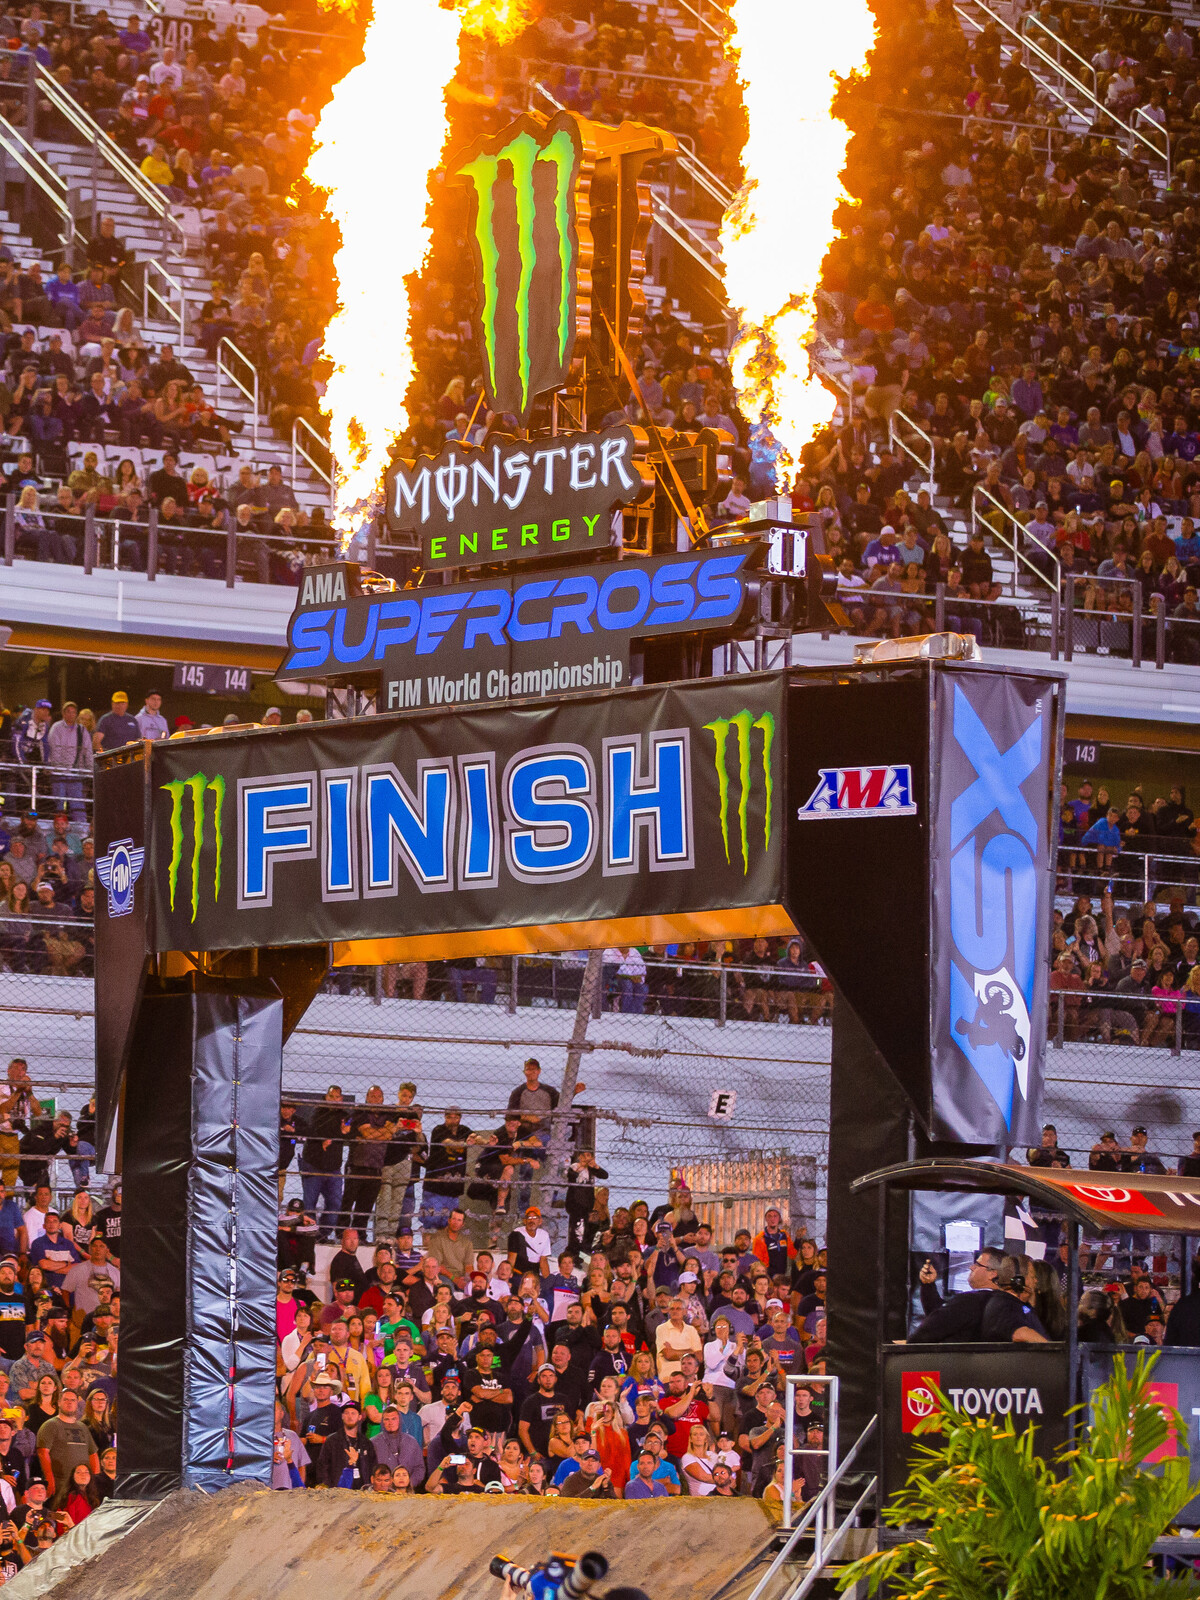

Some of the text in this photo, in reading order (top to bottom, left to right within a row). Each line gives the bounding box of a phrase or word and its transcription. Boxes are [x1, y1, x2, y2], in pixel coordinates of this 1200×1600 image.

[430, 514, 601, 559] ENERGY
[301, 571, 347, 605] AMA
[284, 553, 748, 670] SUPERCROSS
[181, 665, 204, 687] 145
[224, 669, 247, 690] 144
[388, 654, 624, 709] FIM World Championship
[1075, 744, 1096, 763] 143
[800, 765, 916, 812] AMA
[237, 727, 696, 909] FINISH
[112, 863, 129, 893] FIM
[715, 1094, 731, 1114] E
[948, 1387, 1044, 1415] TOYOTA
